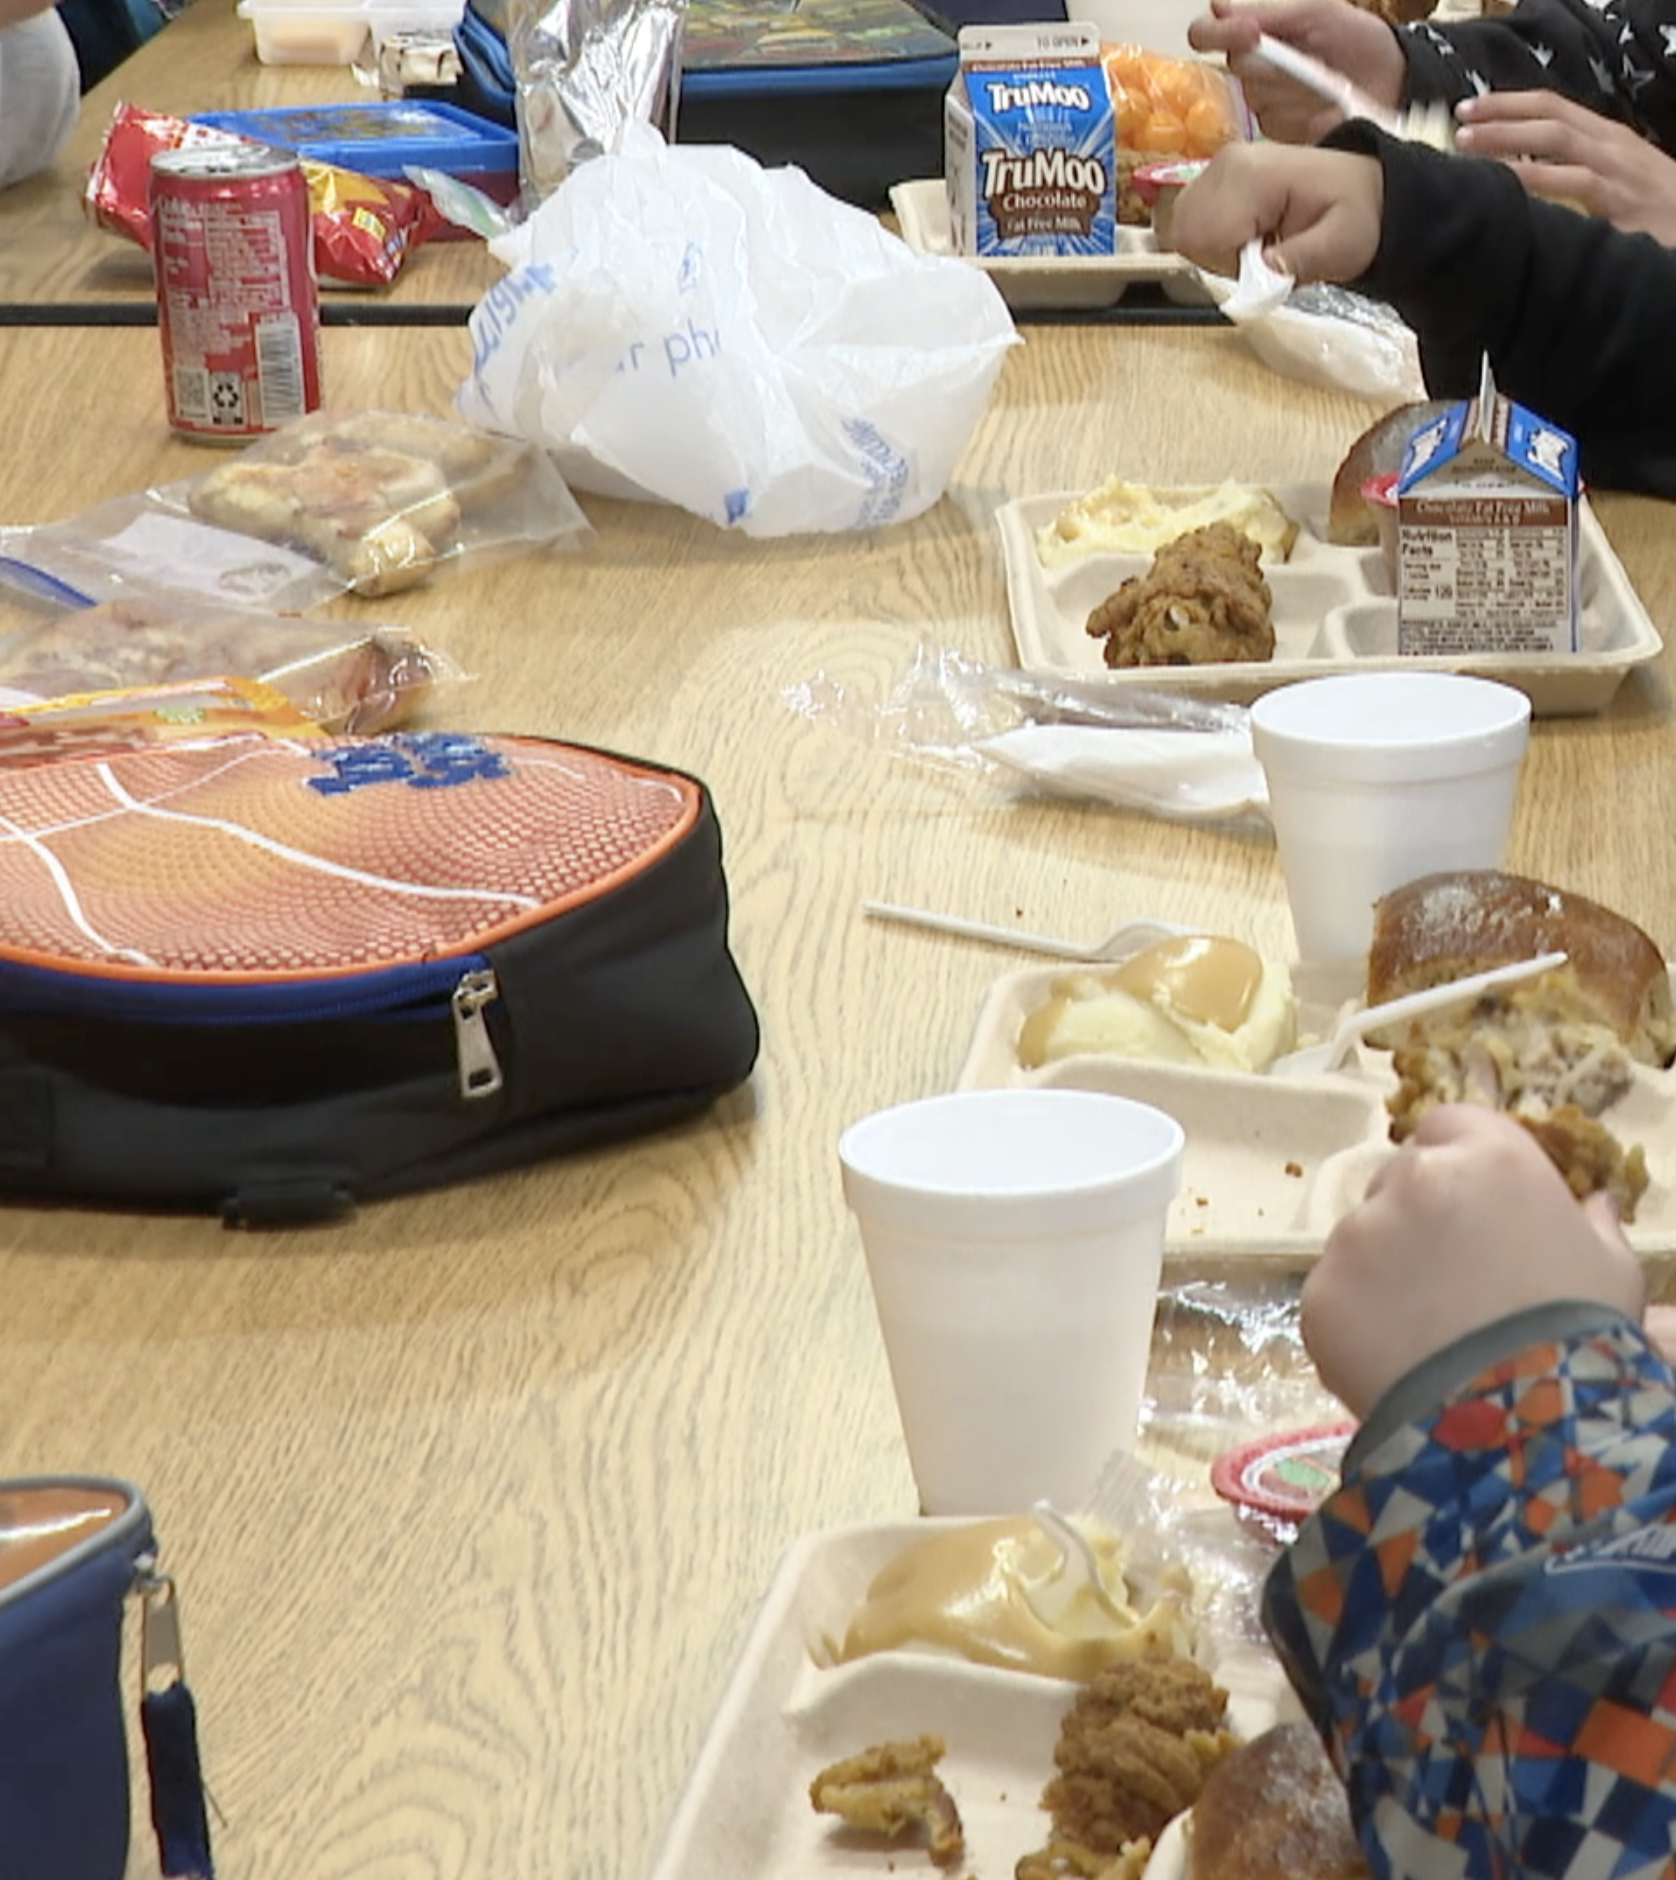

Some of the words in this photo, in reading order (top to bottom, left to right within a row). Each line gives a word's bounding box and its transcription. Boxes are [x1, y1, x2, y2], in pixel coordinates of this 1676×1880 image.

[1053, 36, 1079, 48] OPEN
[986, 80, 1090, 113] TruMoo
[981, 149, 1107, 199] TruMoo
[1002, 192, 1087, 212] Chocolate
[1007, 218, 1026, 231] Fat
[1028, 217, 1052, 231] Free
[1055, 215, 1082, 230] Milk
[1476, 501, 1493, 513] Fat
[1524, 500, 1550, 513] Milk
[1401, 529, 1453, 541] Nutrition
[1401, 543, 1433, 555] Facts
